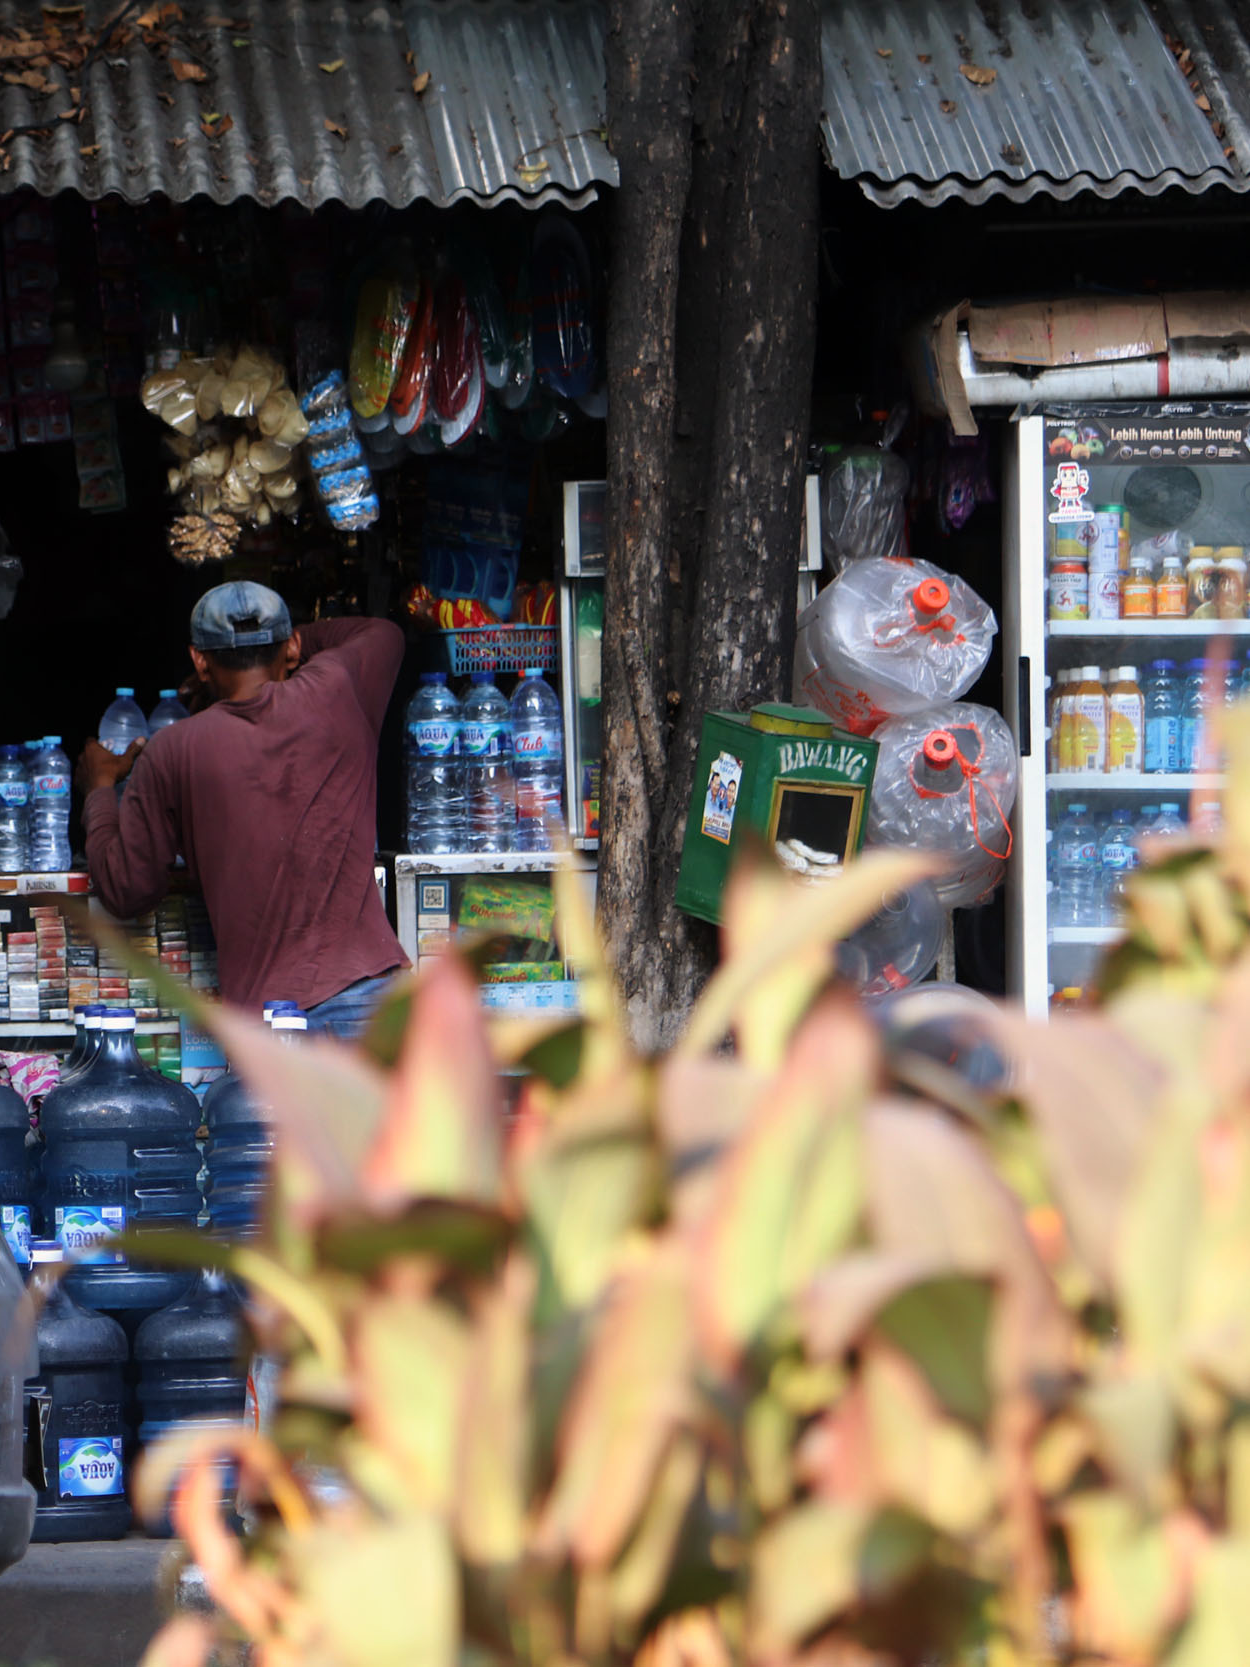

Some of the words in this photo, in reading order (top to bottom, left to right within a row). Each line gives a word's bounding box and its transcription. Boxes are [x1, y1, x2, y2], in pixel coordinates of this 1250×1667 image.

[1110, 427, 1138, 441] Lebih
[1140, 427, 1173, 441] Hemat
[1175, 427, 1202, 440] Lebih
[1205, 427, 1242, 442] Untung
[418, 727, 449, 742] AQUA
[514, 736, 543, 753] Club
[1168, 719, 1177, 768] mizone
[778, 742, 868, 781] BAWANG
[38, 777, 63, 791] Club
[25, 879, 56, 891] Kansas
[79, 1460, 115, 1480] AQUA
